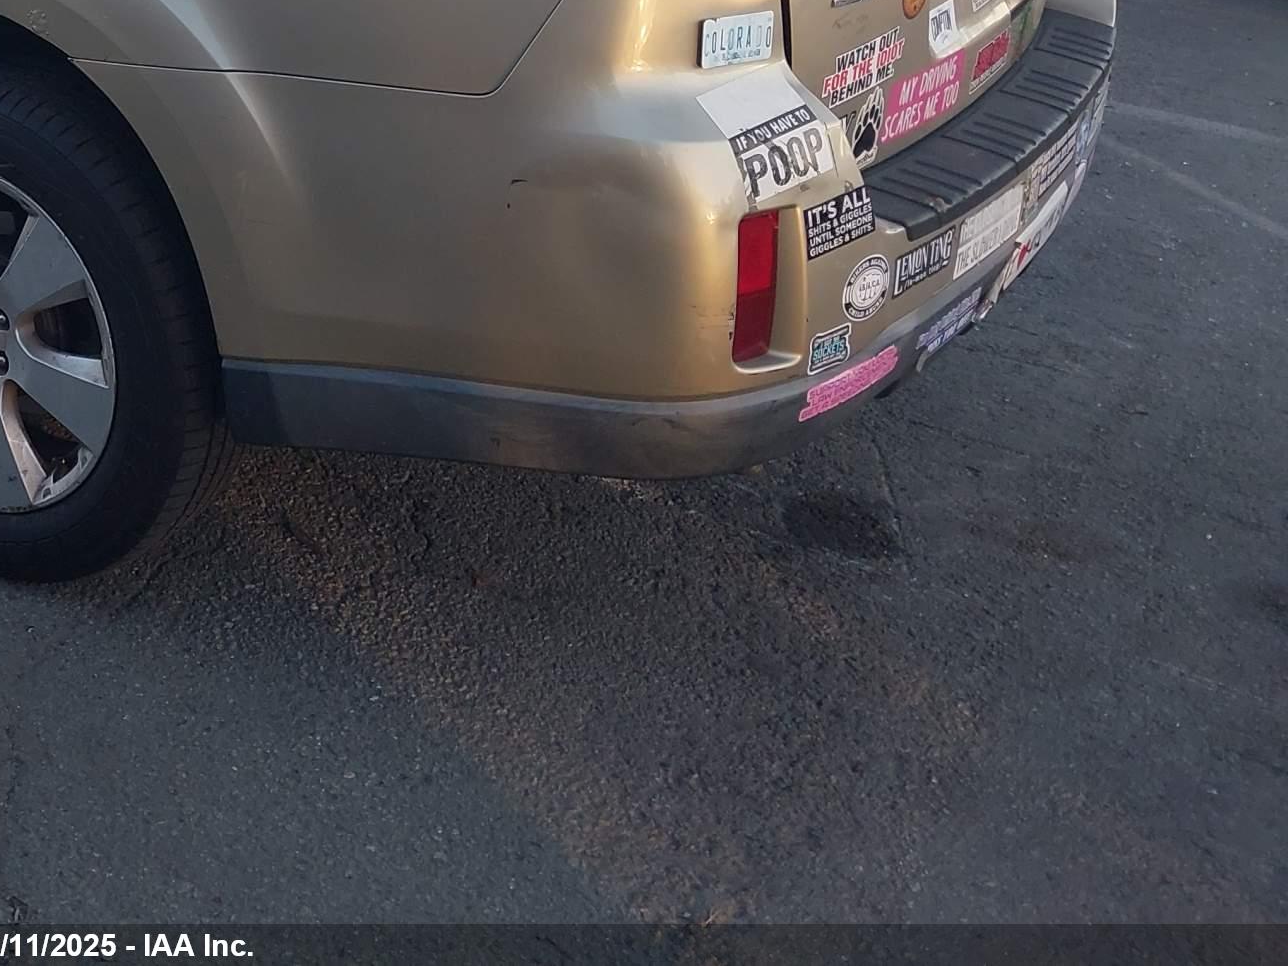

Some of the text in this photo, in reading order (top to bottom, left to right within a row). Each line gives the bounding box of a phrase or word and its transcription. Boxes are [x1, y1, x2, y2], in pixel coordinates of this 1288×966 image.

[704, 24, 773, 58] COLORADO
[837, 29, 900, 72] WATCH OUT
[824, 41, 904, 94] FOR THE IDIOT
[899, 74, 919, 107] MY
[918, 56, 959, 98] DRIVING
[831, 73, 873, 106] BEHIND
[735, 108, 811, 152] IF YOU HAVE TO
[880, 101, 924, 143] SCARES
[923, 91, 941, 121] ME
[941, 80, 960, 112] TOO
[743, 127, 823, 199] POOP
[807, 187, 871, 228] IT'S ALL
[808, 203, 873, 237] SHITS & GIGGLES
[809, 224, 874, 257] GIGGLES & SHITS.
[810, 214, 873, 248] UNTIL SOMEONE
